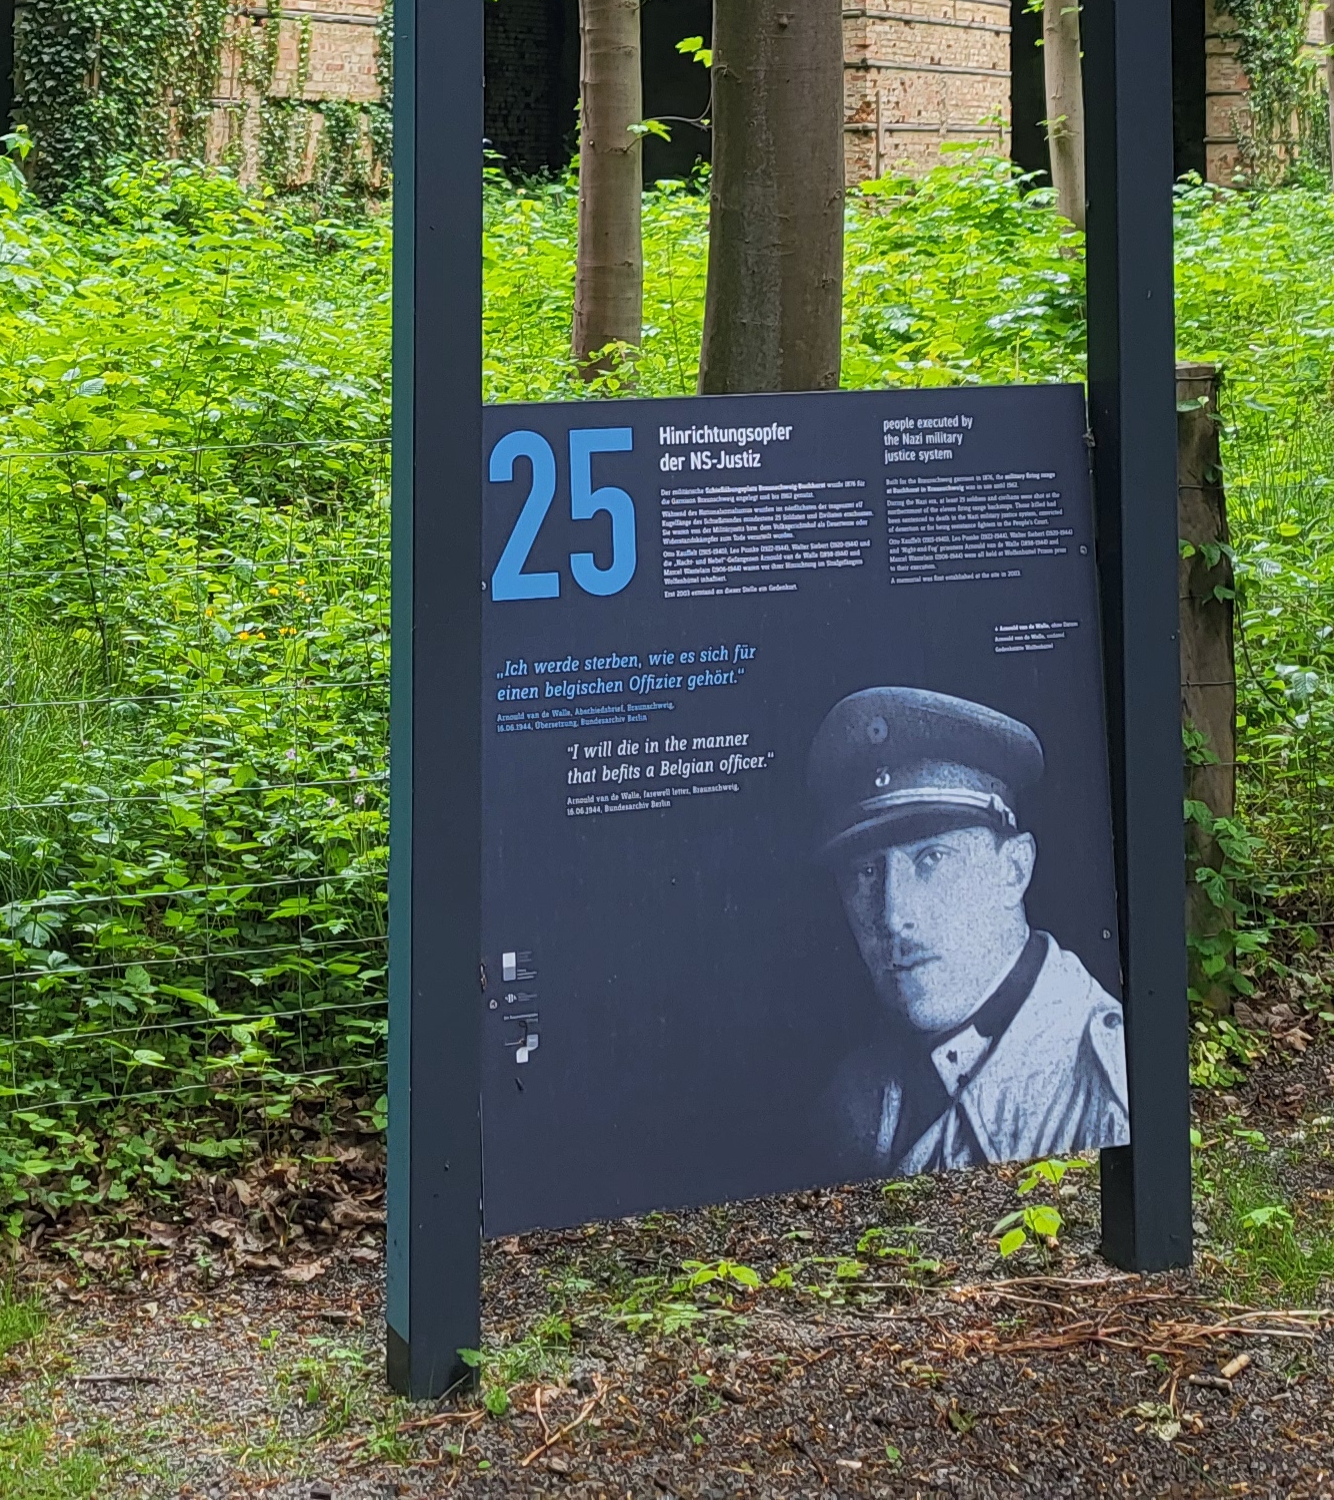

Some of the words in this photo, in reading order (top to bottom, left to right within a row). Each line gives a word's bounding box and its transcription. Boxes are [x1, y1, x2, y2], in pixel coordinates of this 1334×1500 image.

[659, 422, 793, 447] Hinrichtungsopfer
[883, 416, 915, 433] people
[917, 414, 959, 429] executed
[961, 414, 973, 430] by
[883, 433, 900, 446] the
[902, 432, 923, 445] Nazi
[925, 431, 963, 446] military
[659, 452, 686, 472] der
[690, 449, 762, 471] NS-Justiz
[884, 448, 916, 465] justice
[918, 448, 953, 464] system
[489, 427, 637, 602] 25
[496, 659, 528, 679] „Ich
[533, 655, 580, 674] werde
[584, 652, 642, 671] sterben,
[648, 649, 675, 666] wie
[679, 651, 695, 664] es
[699, 645, 729, 663] sich
[732, 644, 757, 664] für
[497, 684, 539, 701] einen
[545, 677, 623, 700] belgischen
[629, 673, 683, 695] Offizier
[687, 667, 745, 691] gehört.“
[526, 712, 540, 720] van
[583, 740, 612, 759] will
[617, 739, 640, 756] die
[644, 738, 659, 754] in
[665, 735, 688, 752] the
[691, 733, 749, 750] manner
[567, 767, 597, 785] that
[601, 763, 641, 784] befits
[645, 765, 655, 778] a
[659, 758, 714, 779] Belgian
[719, 751, 774, 775] officer."
[566, 794, 595, 806] Arnould
[595, 795, 610, 803] van
[610, 792, 619, 801] de
[620, 791, 642, 803] Walle,
[604, 801, 650, 813] Bundesarchiv
[650, 799, 671, 809] Berlin
